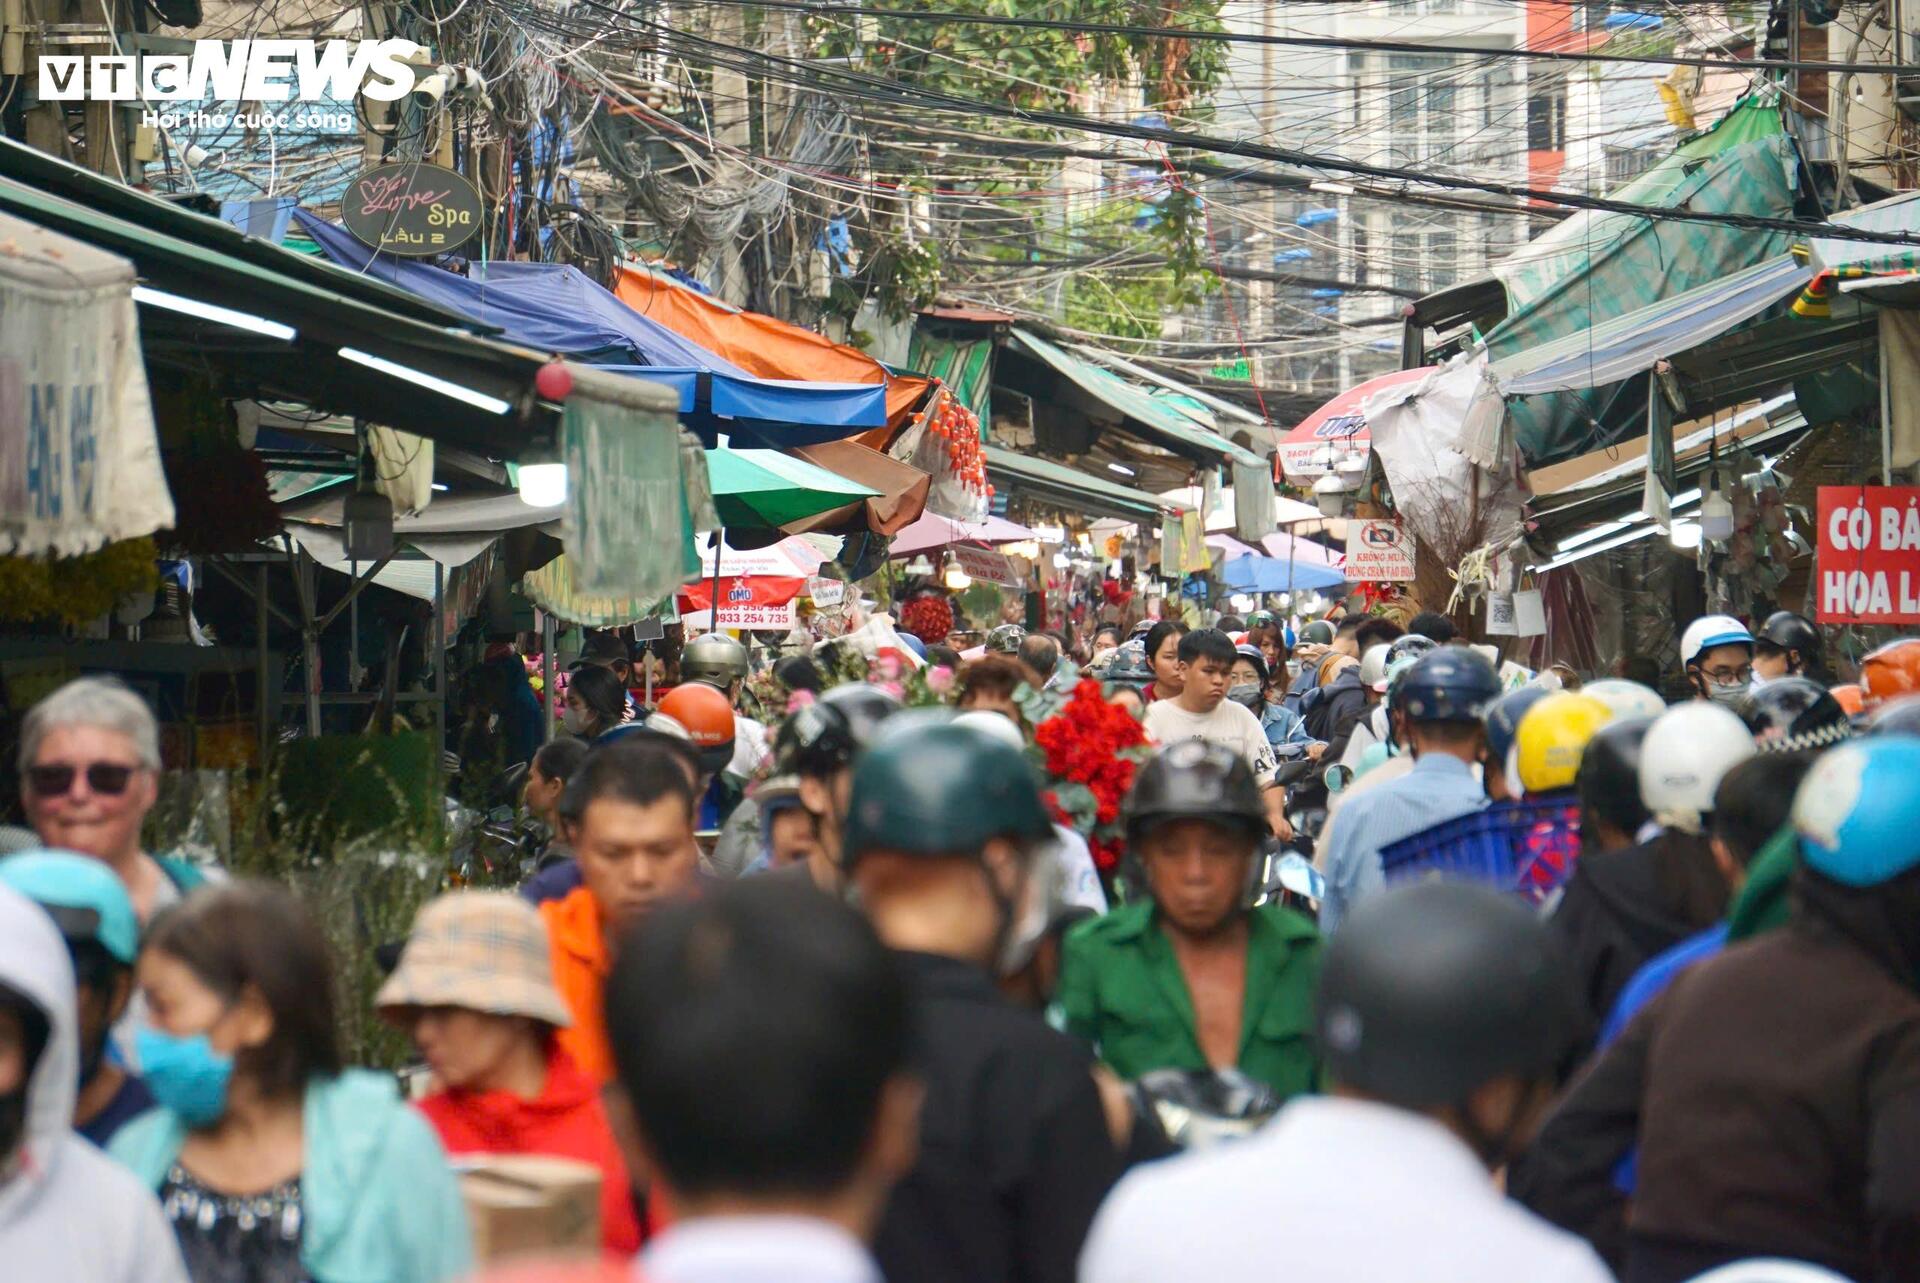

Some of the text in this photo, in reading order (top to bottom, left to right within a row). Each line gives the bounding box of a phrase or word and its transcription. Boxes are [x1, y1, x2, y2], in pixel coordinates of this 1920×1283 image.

[428, 203, 471, 228] Spa
[431, 233, 445, 244] 2
[1829, 496, 1872, 551] CÓ
[728, 589, 752, 601] OMO
[1824, 570, 1920, 615] HOA L
[743, 613, 764, 623] 254
[767, 613, 788, 623] 735
